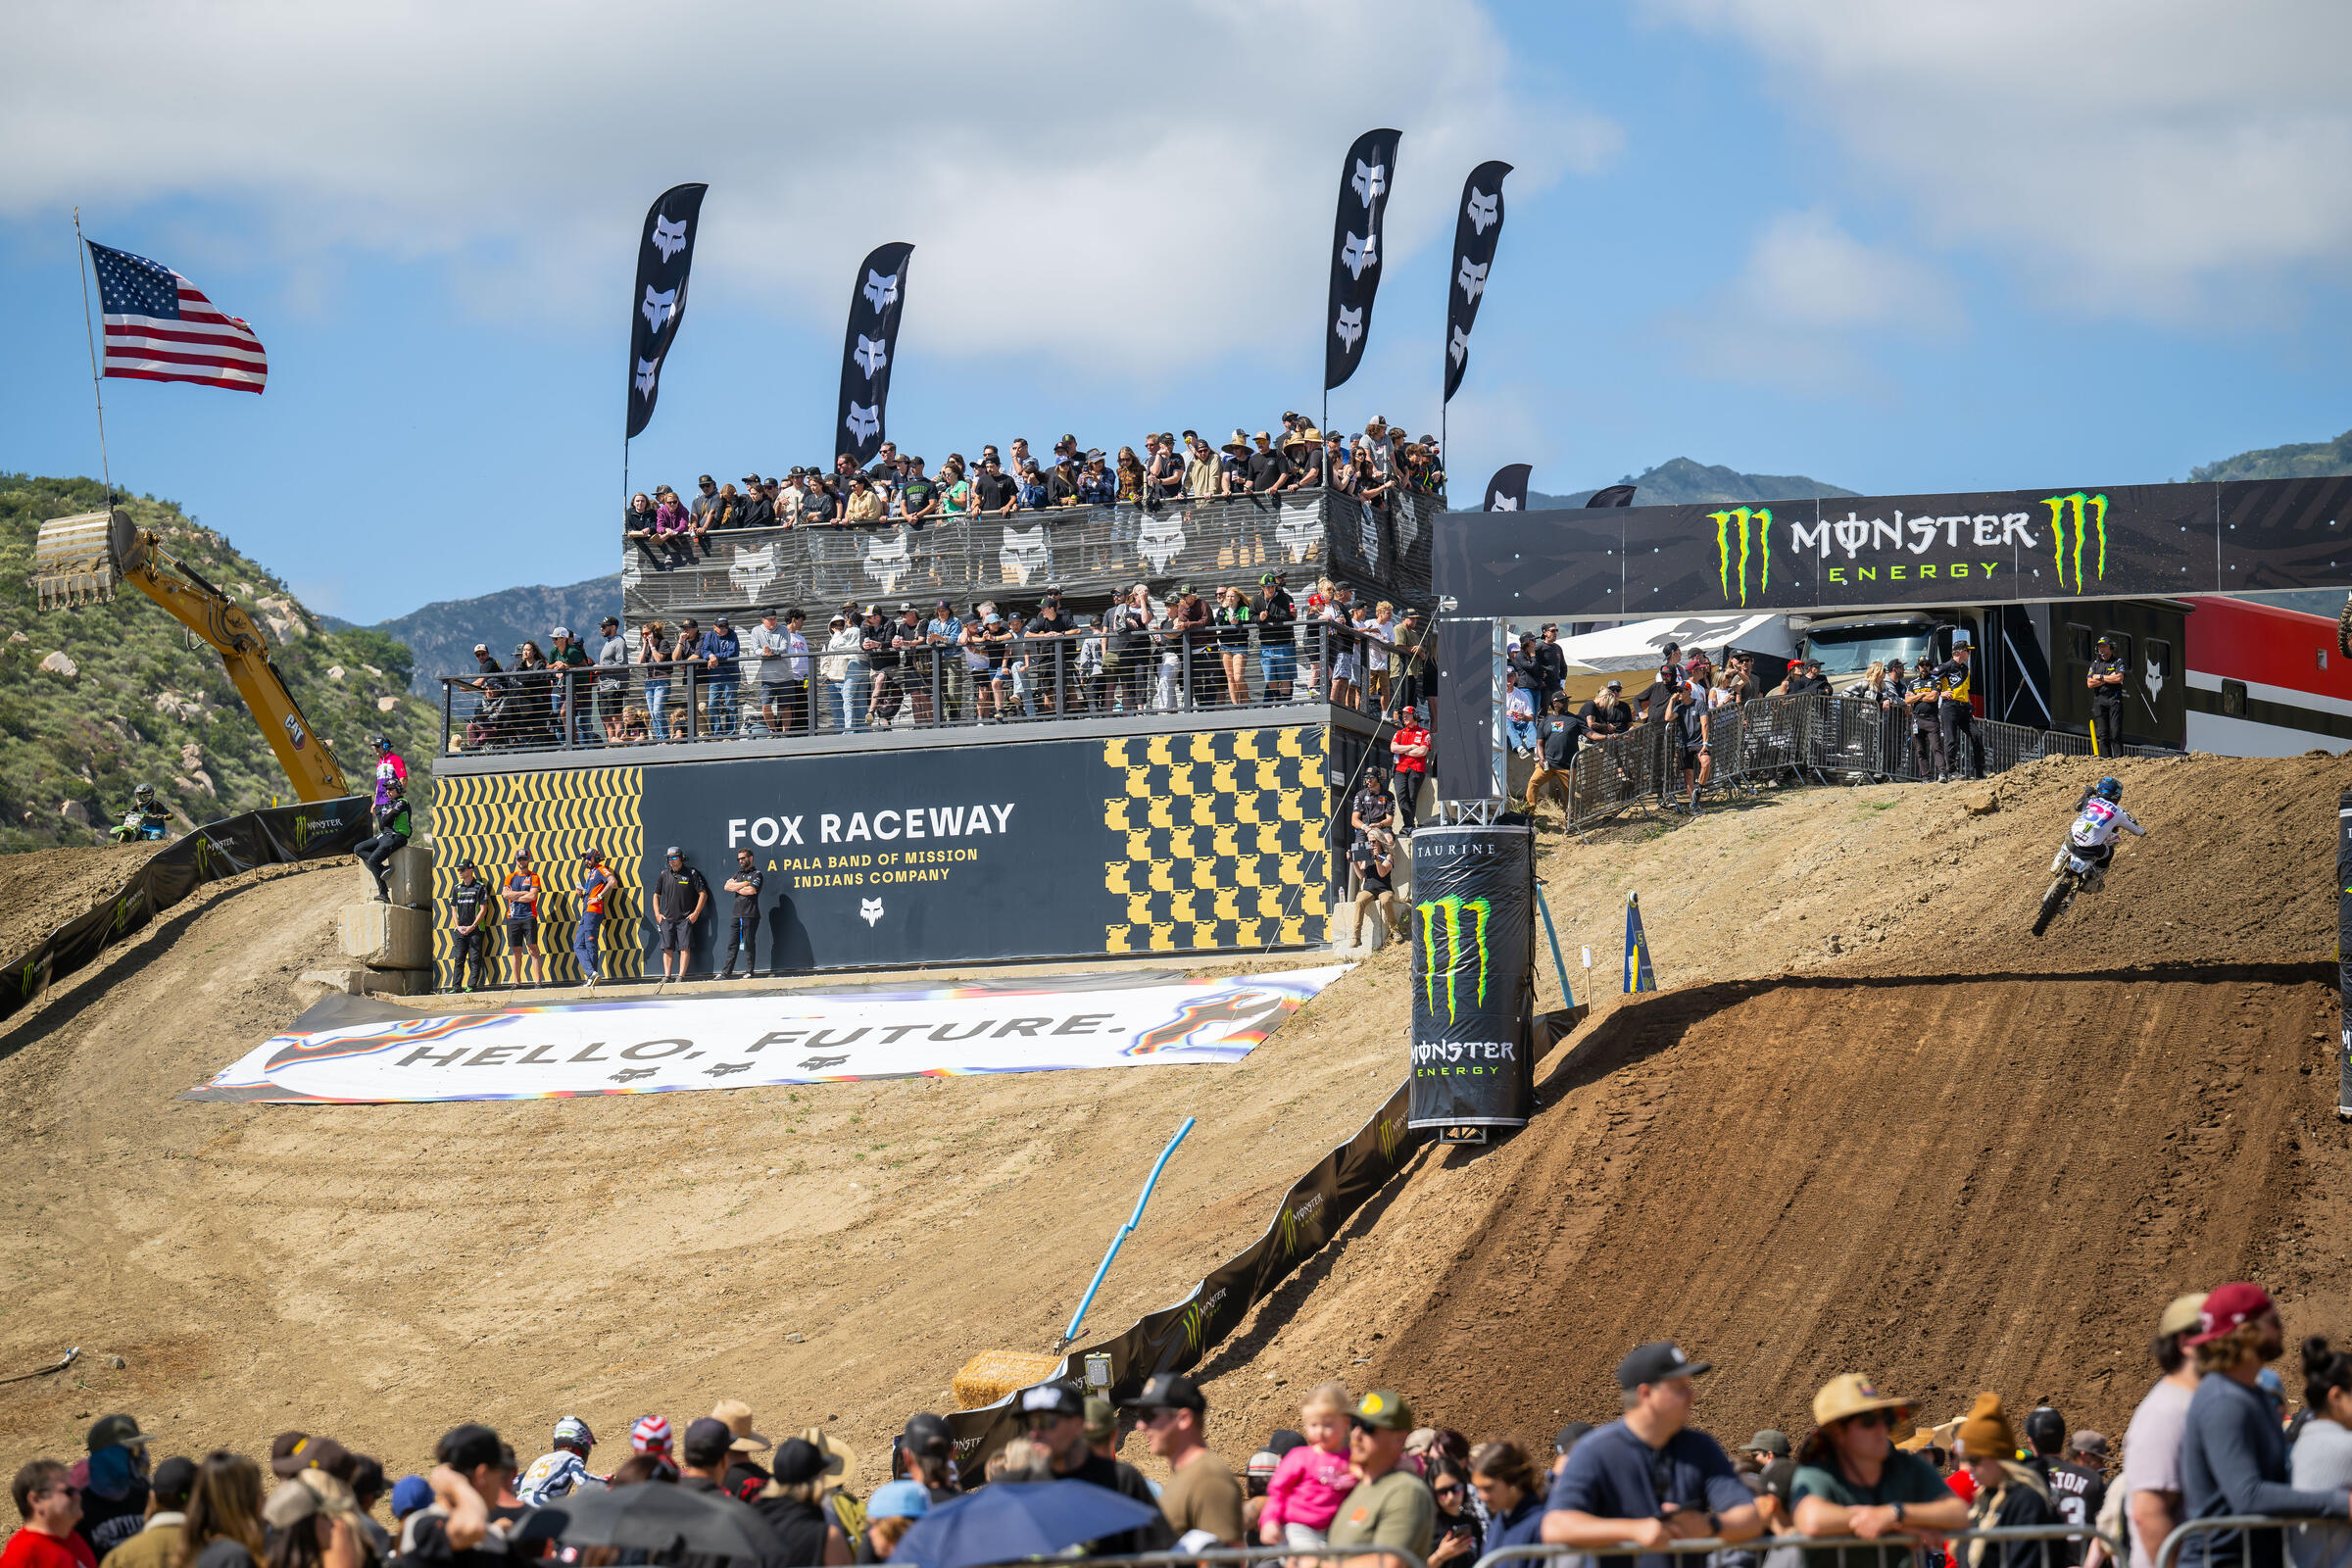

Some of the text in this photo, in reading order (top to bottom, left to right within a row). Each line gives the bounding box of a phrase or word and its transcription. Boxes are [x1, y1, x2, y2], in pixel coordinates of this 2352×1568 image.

[1790, 510, 2037, 559] MONSTER
[1830, 562, 1998, 582] ENERGY
[284, 712, 304, 743] CAT
[307, 818, 343, 830] MONSTER
[728, 803, 1015, 848] FOX RACEWAY
[2082, 804, 2115, 827] 31
[767, 848, 978, 872] A PALA BAND OF MISSION
[1418, 844, 1495, 858] TAURINE
[794, 868, 950, 889] INDIANS COMPANY
[1638, 933, 1643, 945] 5
[395, 1012, 1126, 1067] HELLO, FUTURE.
[1411, 1039, 1516, 1065] MONSTER
[1417, 1066, 1498, 1077] ENERGY
[1293, 1193, 1323, 1222] MONSTER
[1200, 1288, 1226, 1317] MNSTER
